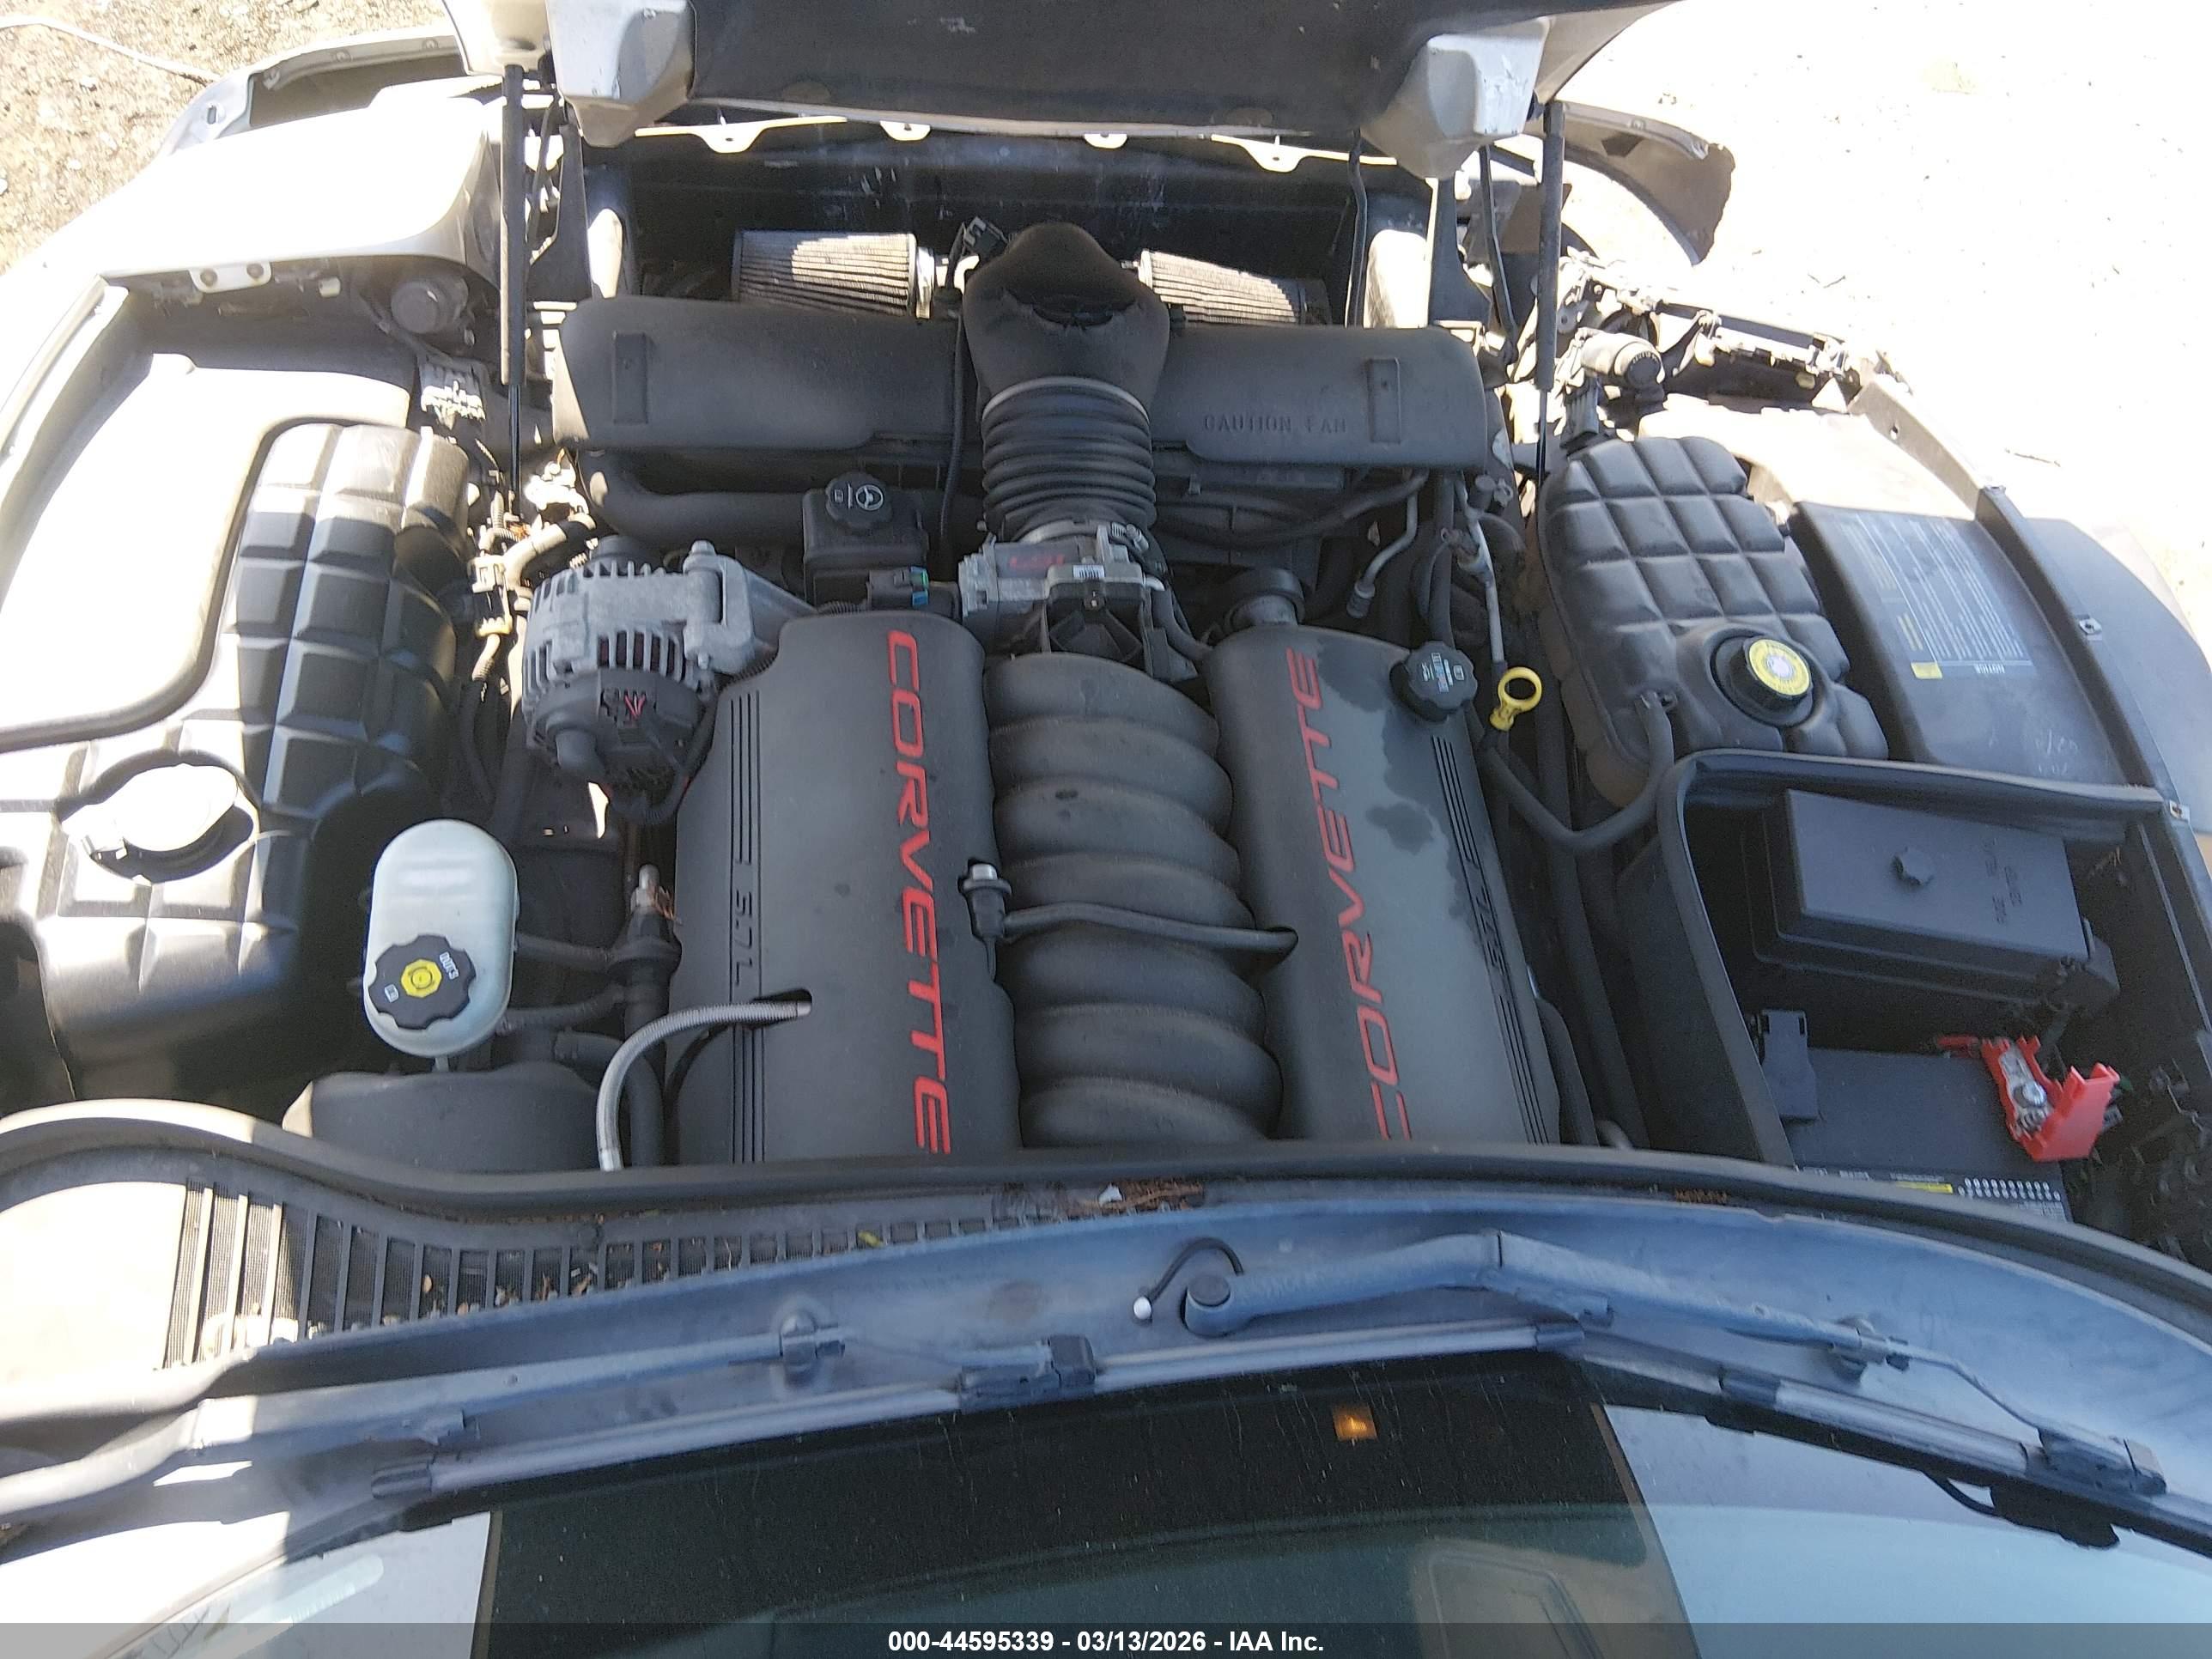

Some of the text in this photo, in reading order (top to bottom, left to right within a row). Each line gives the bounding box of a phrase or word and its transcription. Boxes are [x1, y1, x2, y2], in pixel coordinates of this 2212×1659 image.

[1204, 414, 1291, 433] CAUTION
[735, 889, 754, 987] 5.7L
[888, 630, 951, 1154] CORVETTE
